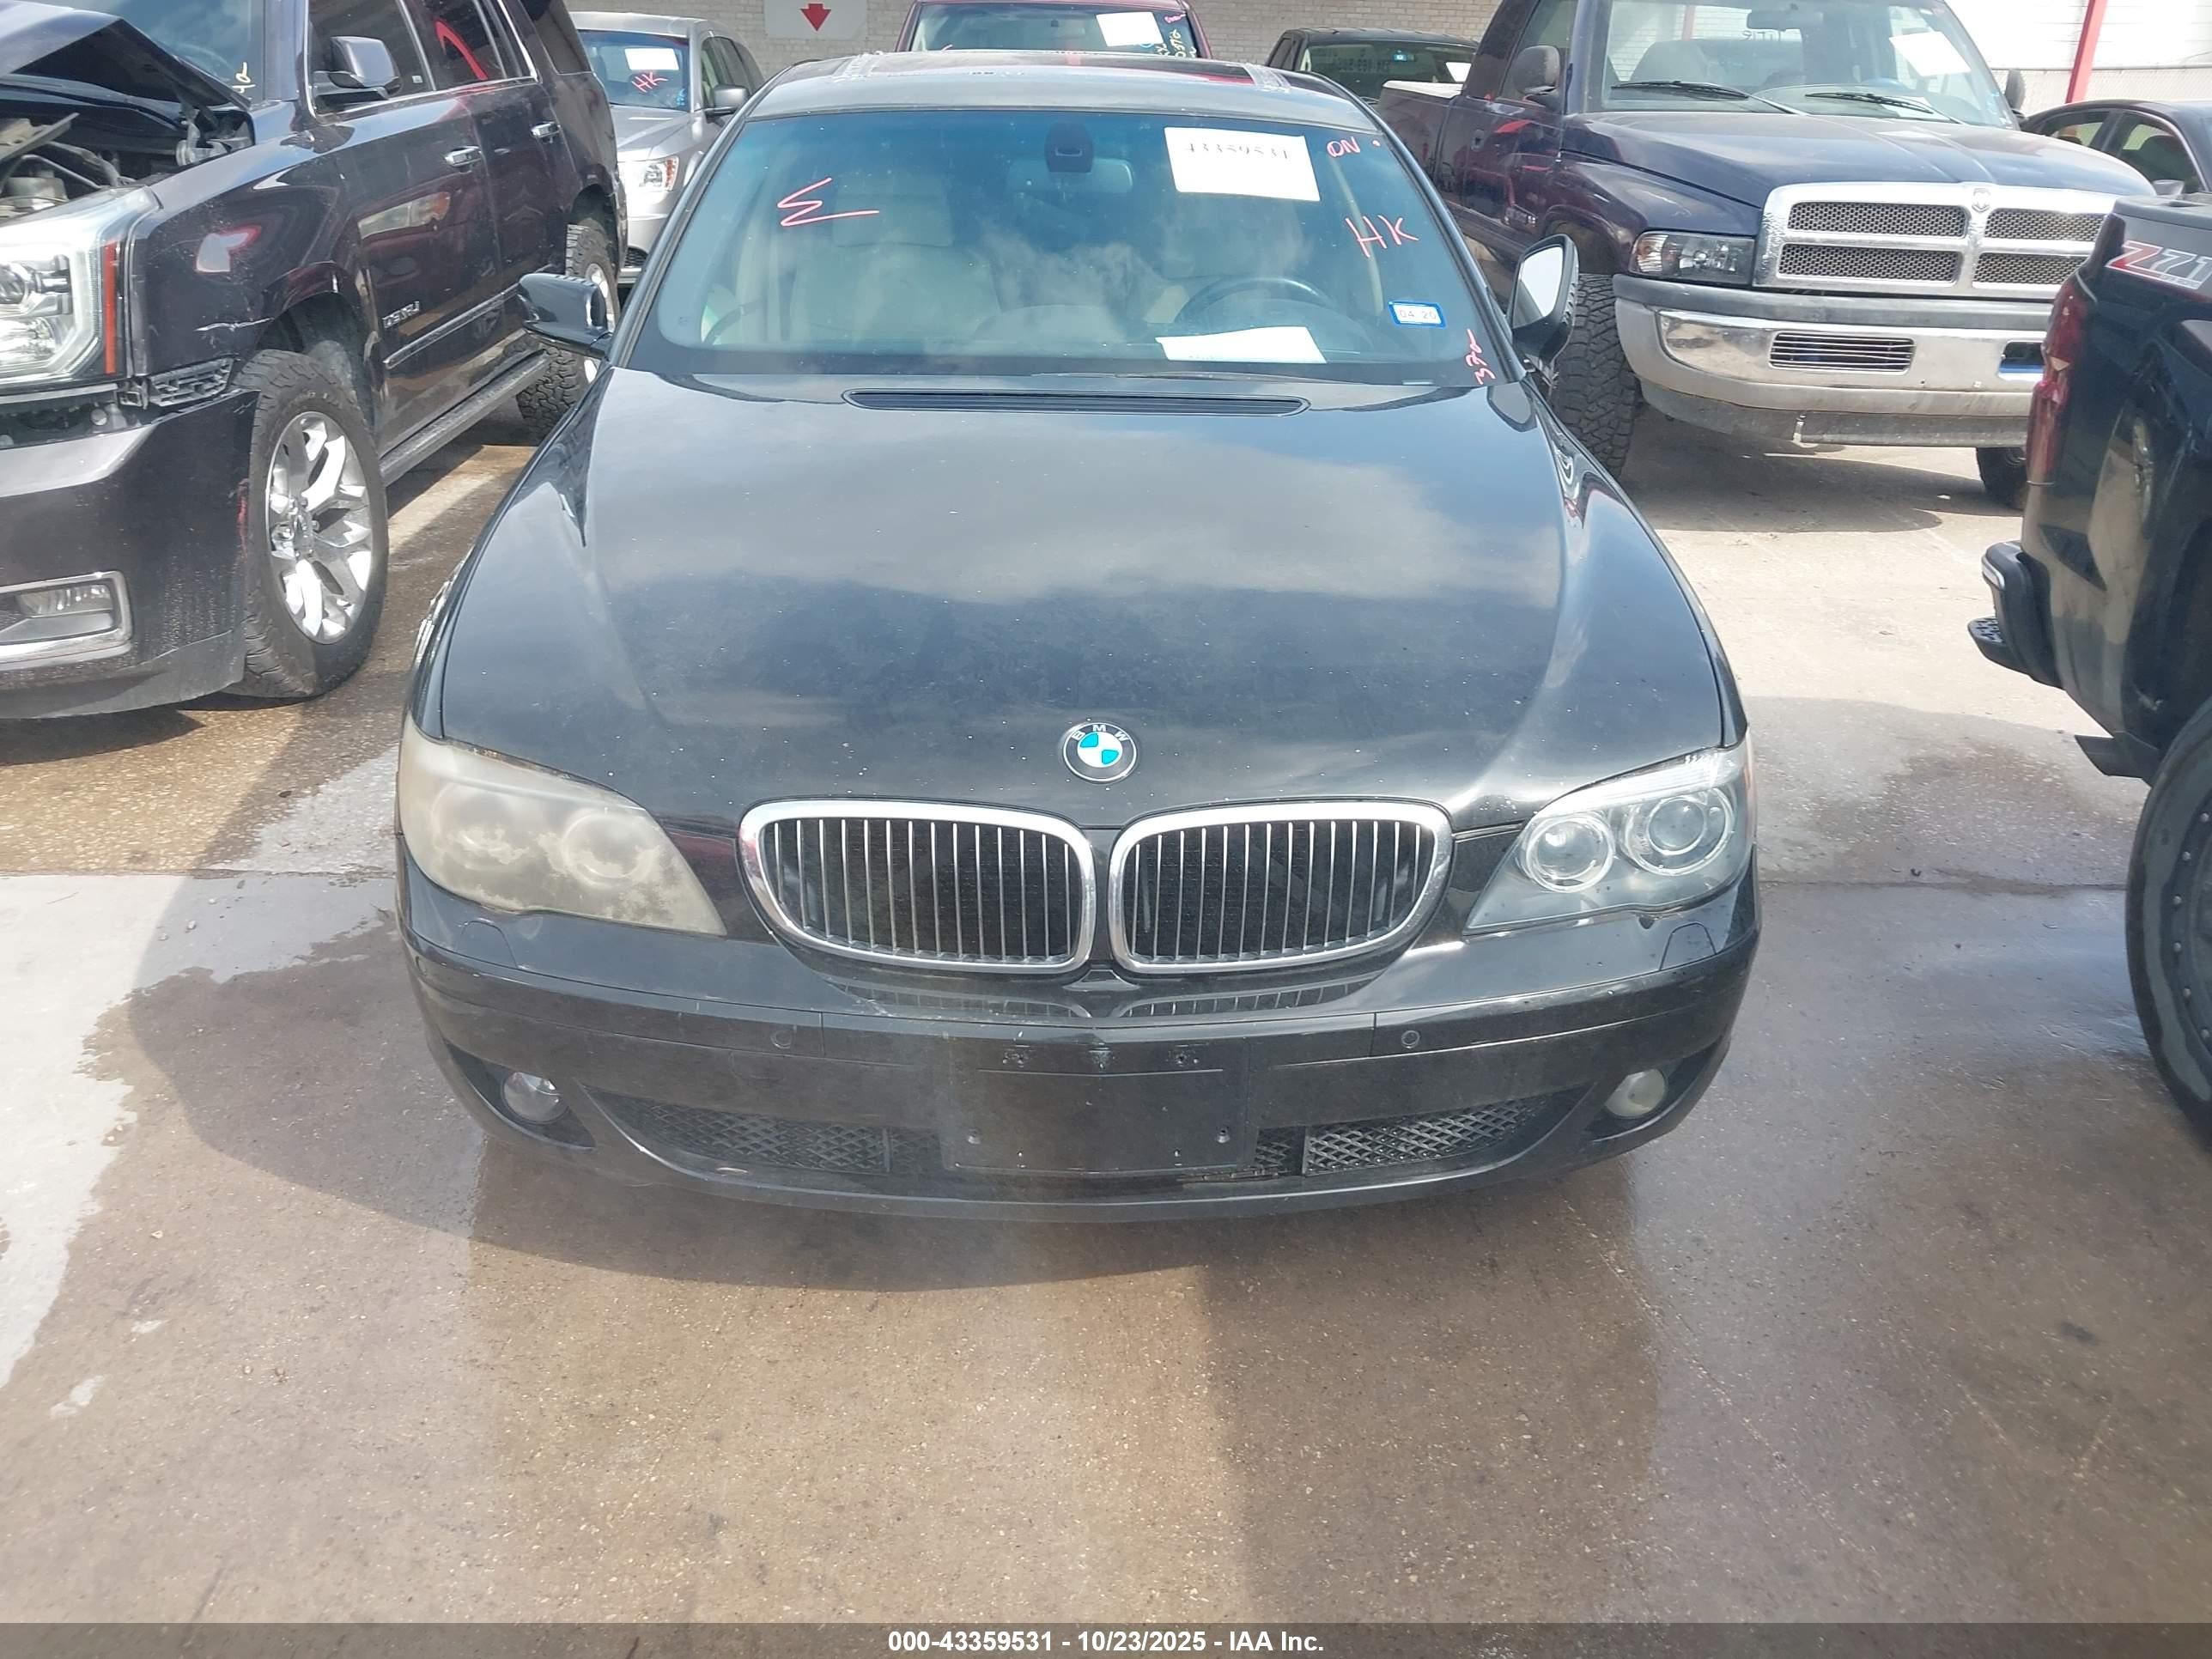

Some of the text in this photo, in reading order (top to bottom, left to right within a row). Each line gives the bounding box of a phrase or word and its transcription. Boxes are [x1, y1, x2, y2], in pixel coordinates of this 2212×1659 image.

[631, 71, 669, 93] HK
[1345, 215, 1419, 258] HK
[2105, 240, 2212, 289] Z71
[1071, 724, 1130, 742] BMW
